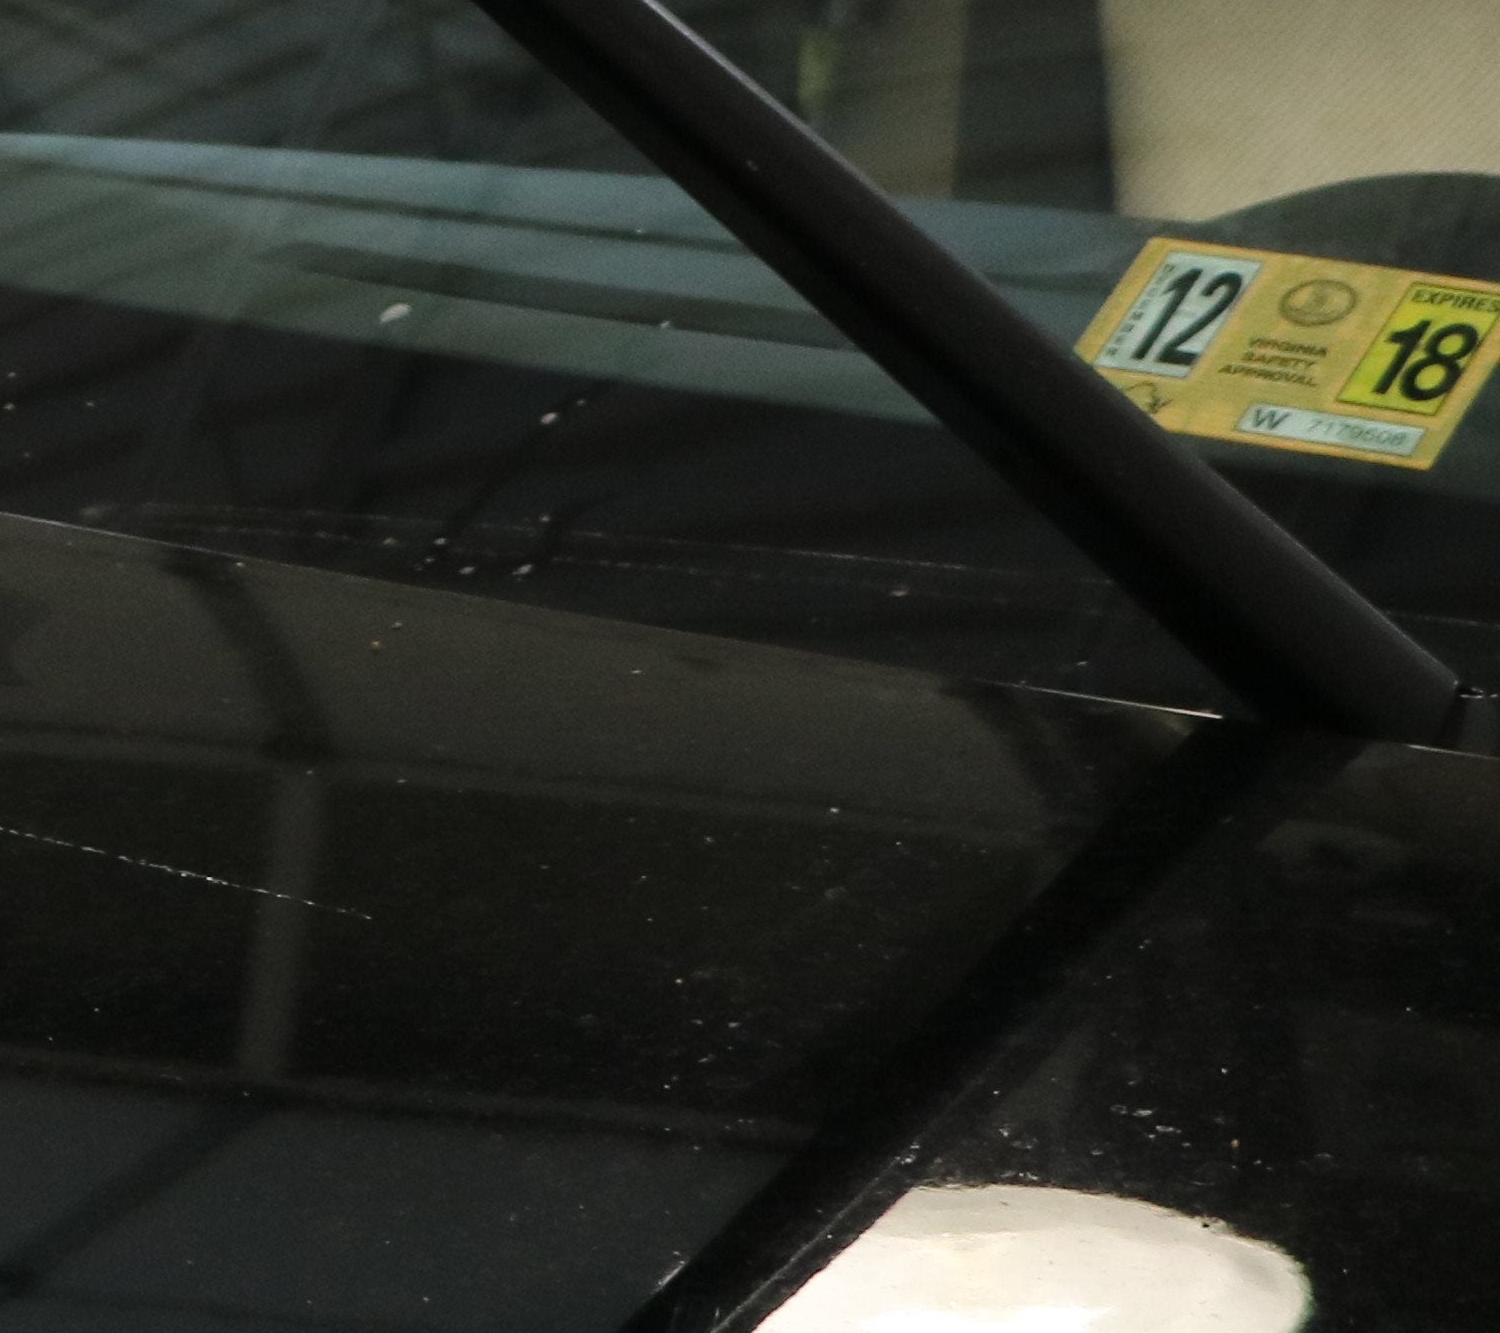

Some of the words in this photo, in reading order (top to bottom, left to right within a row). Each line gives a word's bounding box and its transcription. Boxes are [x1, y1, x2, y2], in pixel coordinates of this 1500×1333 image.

[1411, 288, 1500, 313] EXPIRES
[1130, 267, 1244, 366] 12
[1248, 337, 1328, 357] VIRGINIA
[1242, 350, 1316, 369] SAFETY
[1371, 319, 1480, 402] 18
[1218, 364, 1318, 387] APPROVAL
[1252, 408, 1291, 430] W
